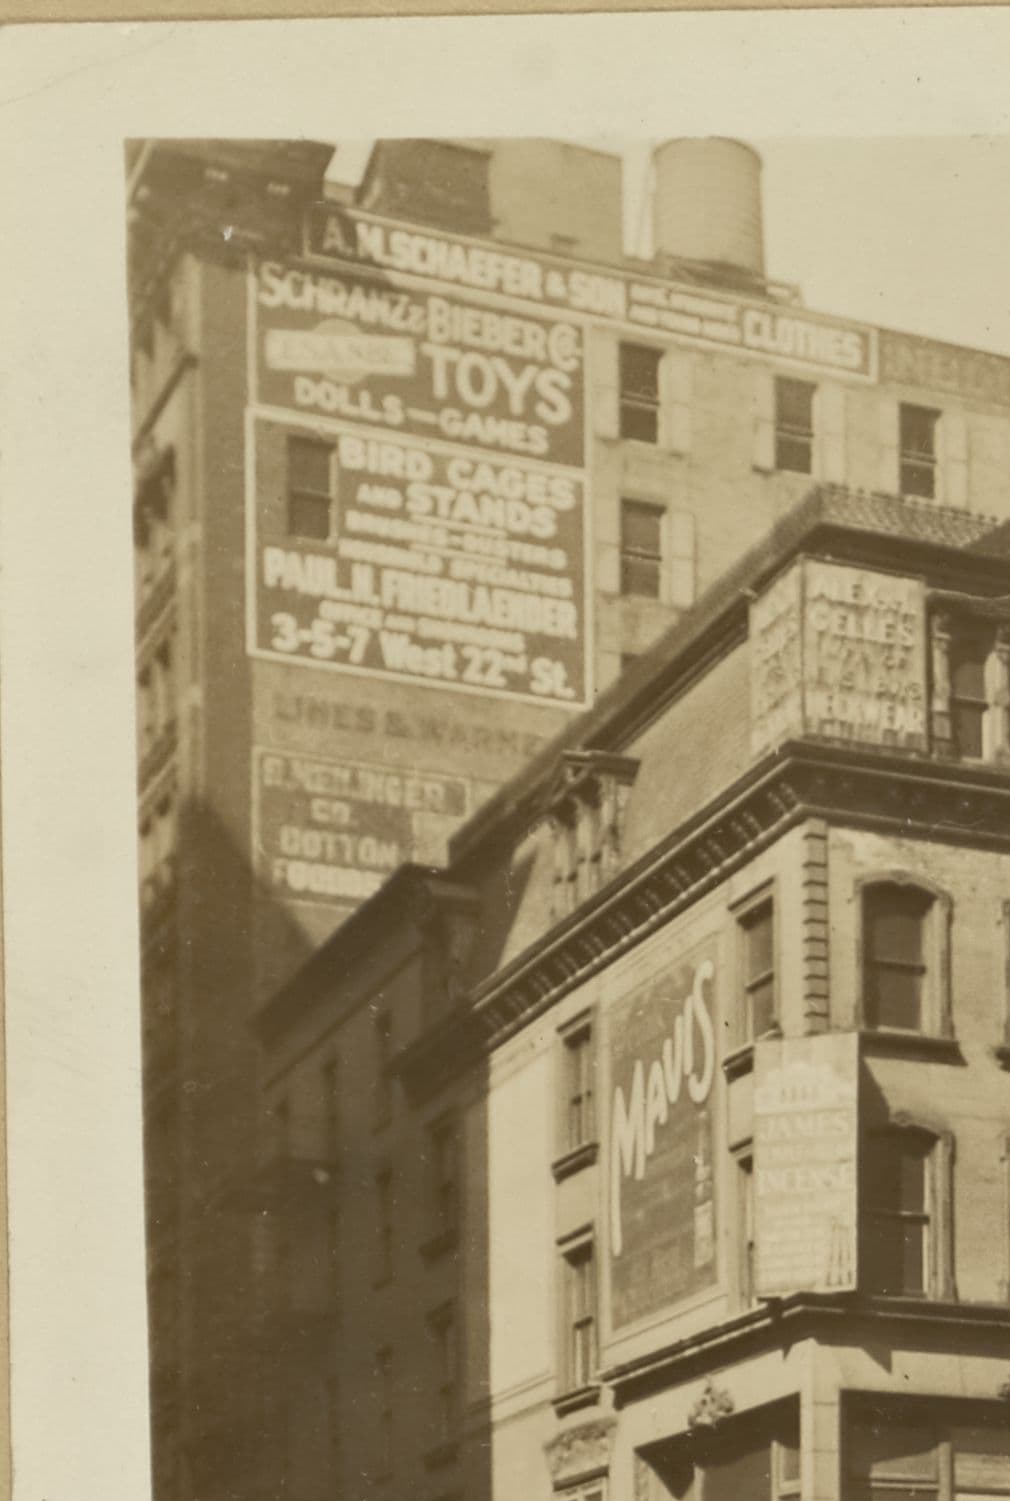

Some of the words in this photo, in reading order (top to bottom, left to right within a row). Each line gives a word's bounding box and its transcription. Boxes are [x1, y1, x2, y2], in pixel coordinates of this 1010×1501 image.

[391, 231, 543, 299] SCHAEFER
[545, 270, 567, 299] &
[427, 296, 546, 362] BIEBER
[743, 307, 863, 371] CLOTHES
[294, 376, 404, 427] DOLLS
[438, 407, 550, 454] GAMES
[420, 342, 573, 425] TOYS
[338, 434, 433, 484] BIRD
[446, 458, 577, 512] CAGES
[405, 482, 557, 540] STANDS
[270, 612, 371, 665] 3-5-7
[378, 630, 458, 679] West
[529, 655, 577, 700] St.
[279, 824, 399, 867] COTTON
